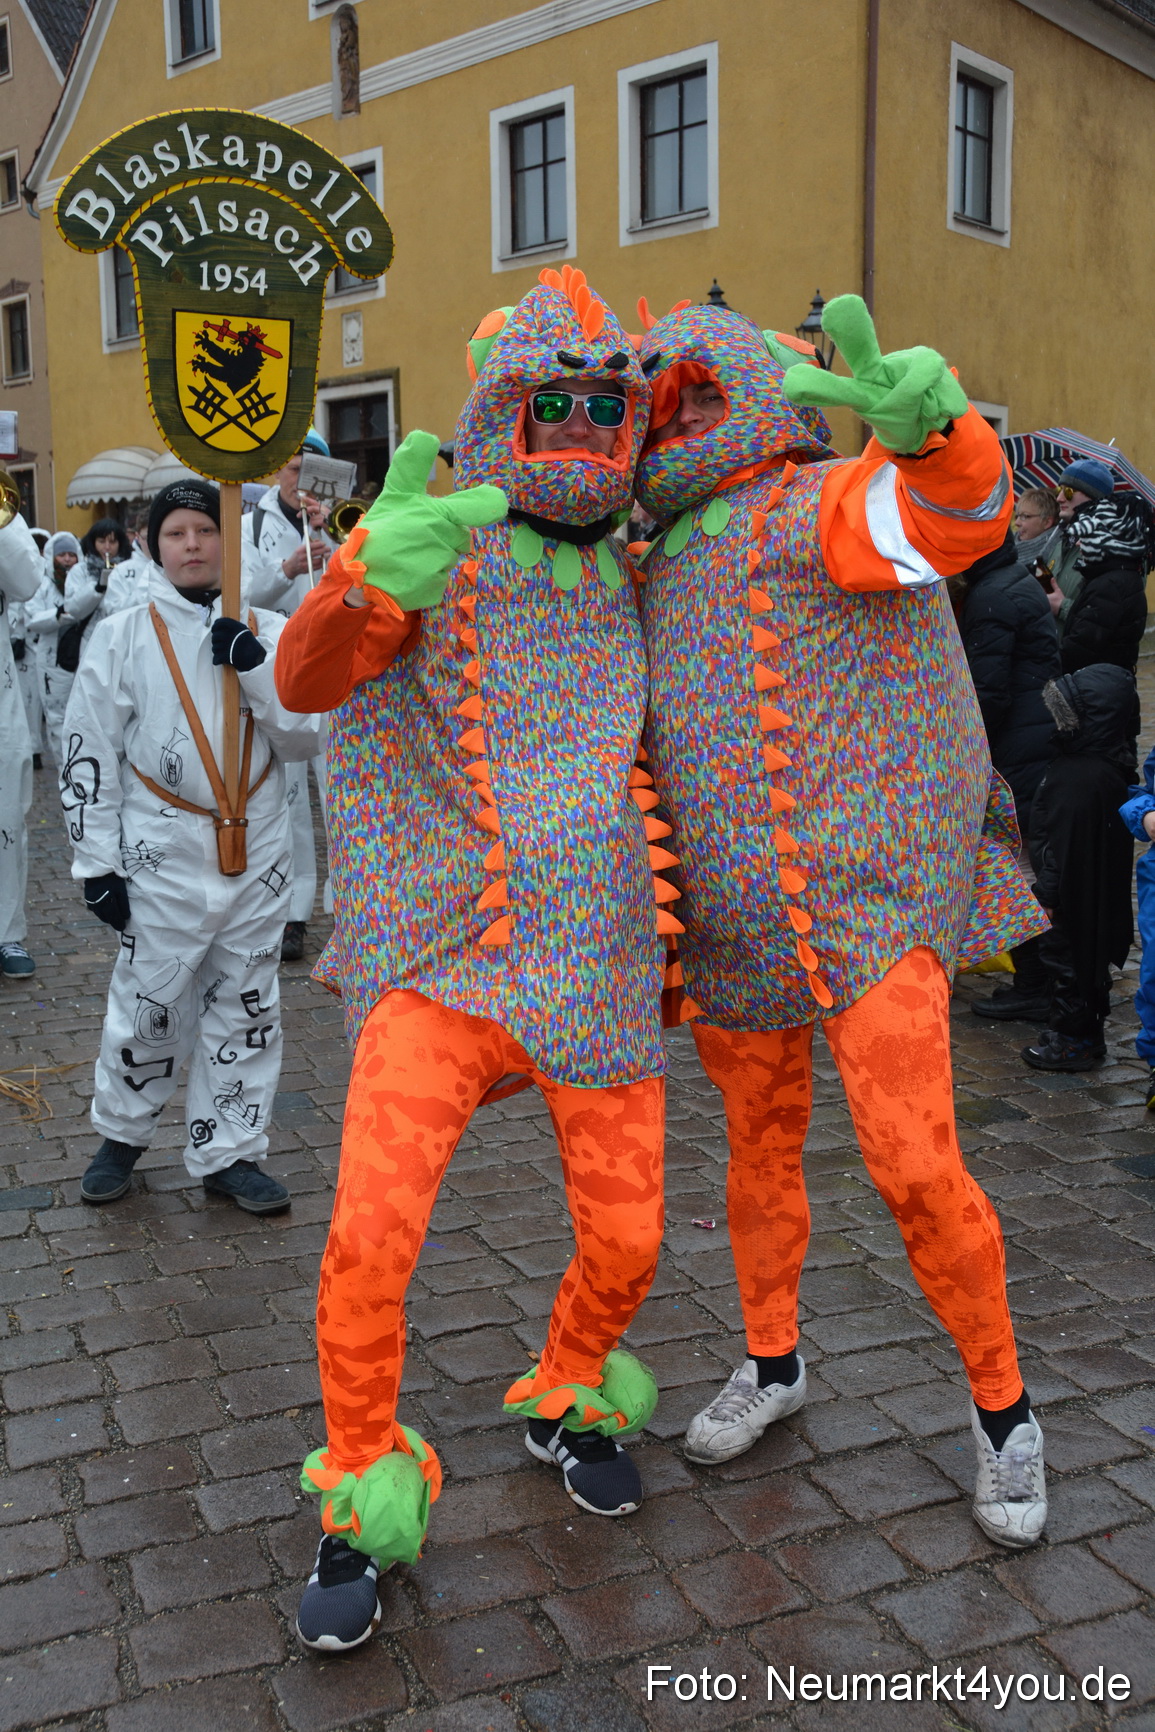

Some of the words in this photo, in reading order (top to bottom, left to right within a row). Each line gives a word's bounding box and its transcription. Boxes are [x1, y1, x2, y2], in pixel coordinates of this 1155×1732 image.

[64, 122, 373, 253] Blaskapelle
[130, 195, 323, 286] Pilsach
[199, 260, 269, 296] 1954
